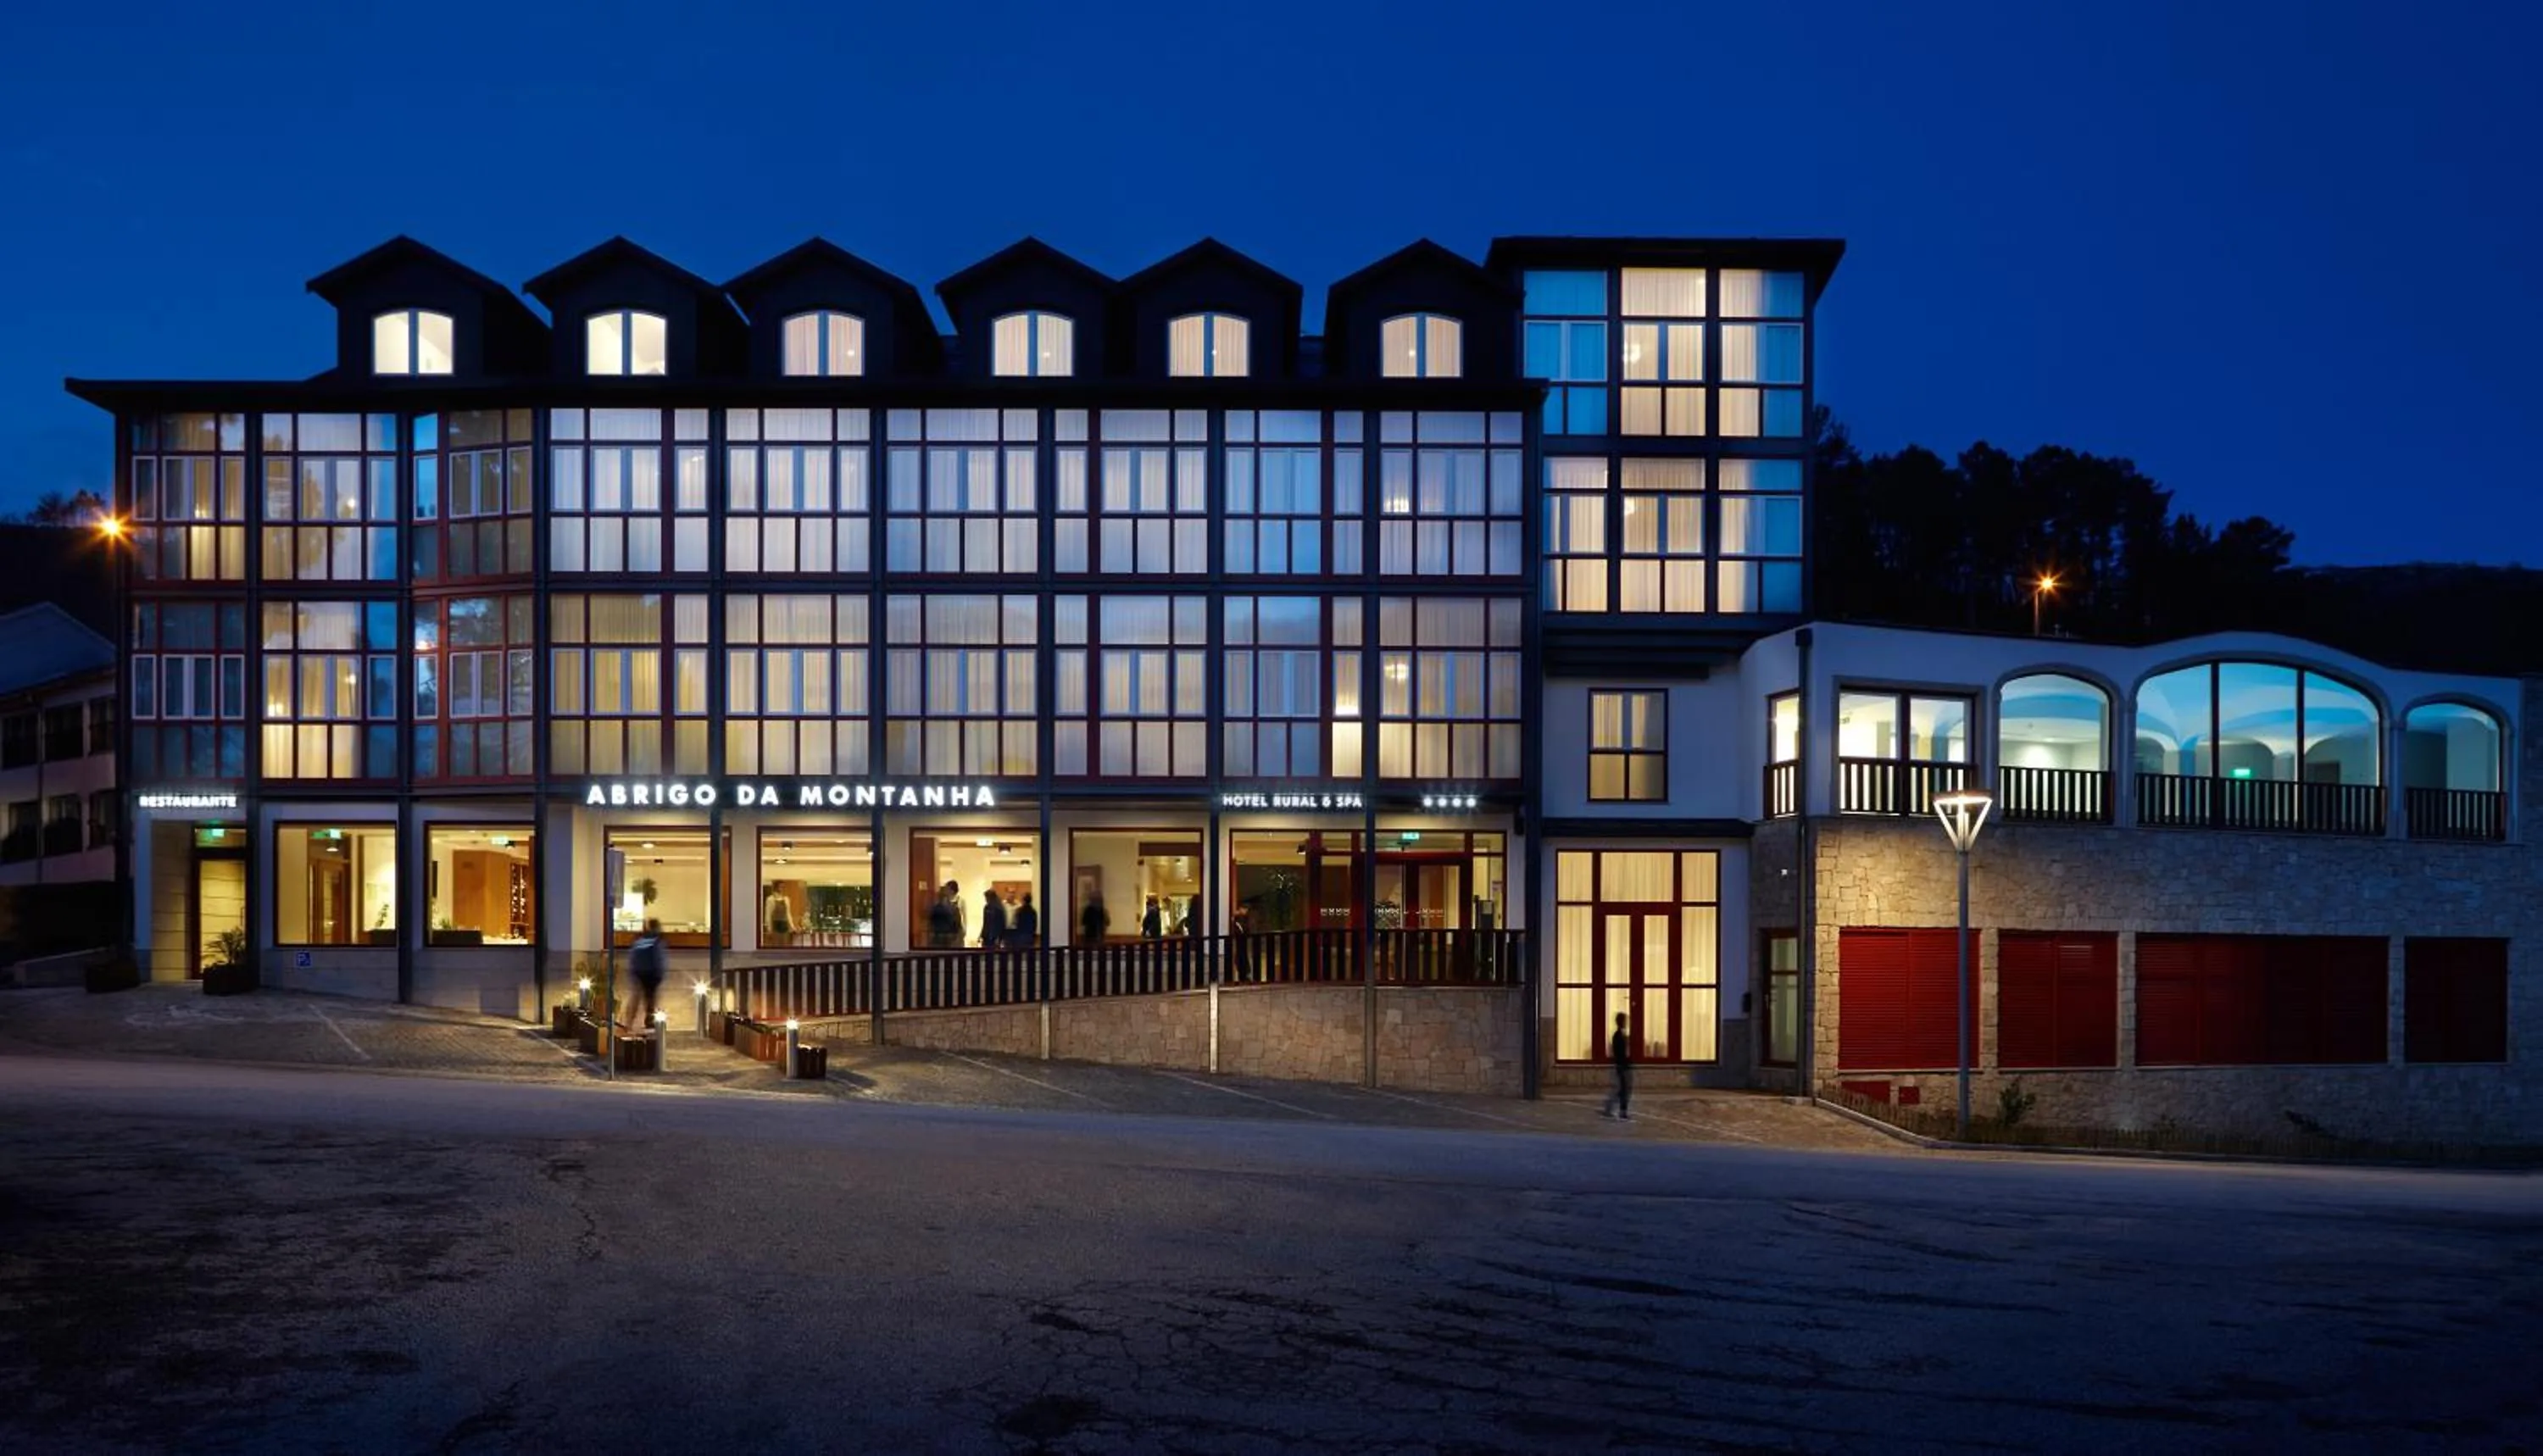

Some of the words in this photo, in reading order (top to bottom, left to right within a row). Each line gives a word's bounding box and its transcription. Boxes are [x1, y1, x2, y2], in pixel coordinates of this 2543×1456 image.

[587, 783, 716, 805] ABRIGO
[737, 784, 779, 805] DA
[799, 784, 995, 806] MONTANHA
[1222, 795, 1268, 807] HOTEL
[1273, 795, 1317, 807] RURAL
[1322, 795, 1331, 807] &
[1336, 795, 1362, 807] SPA
[139, 795, 237, 808] RESTAURANTE
